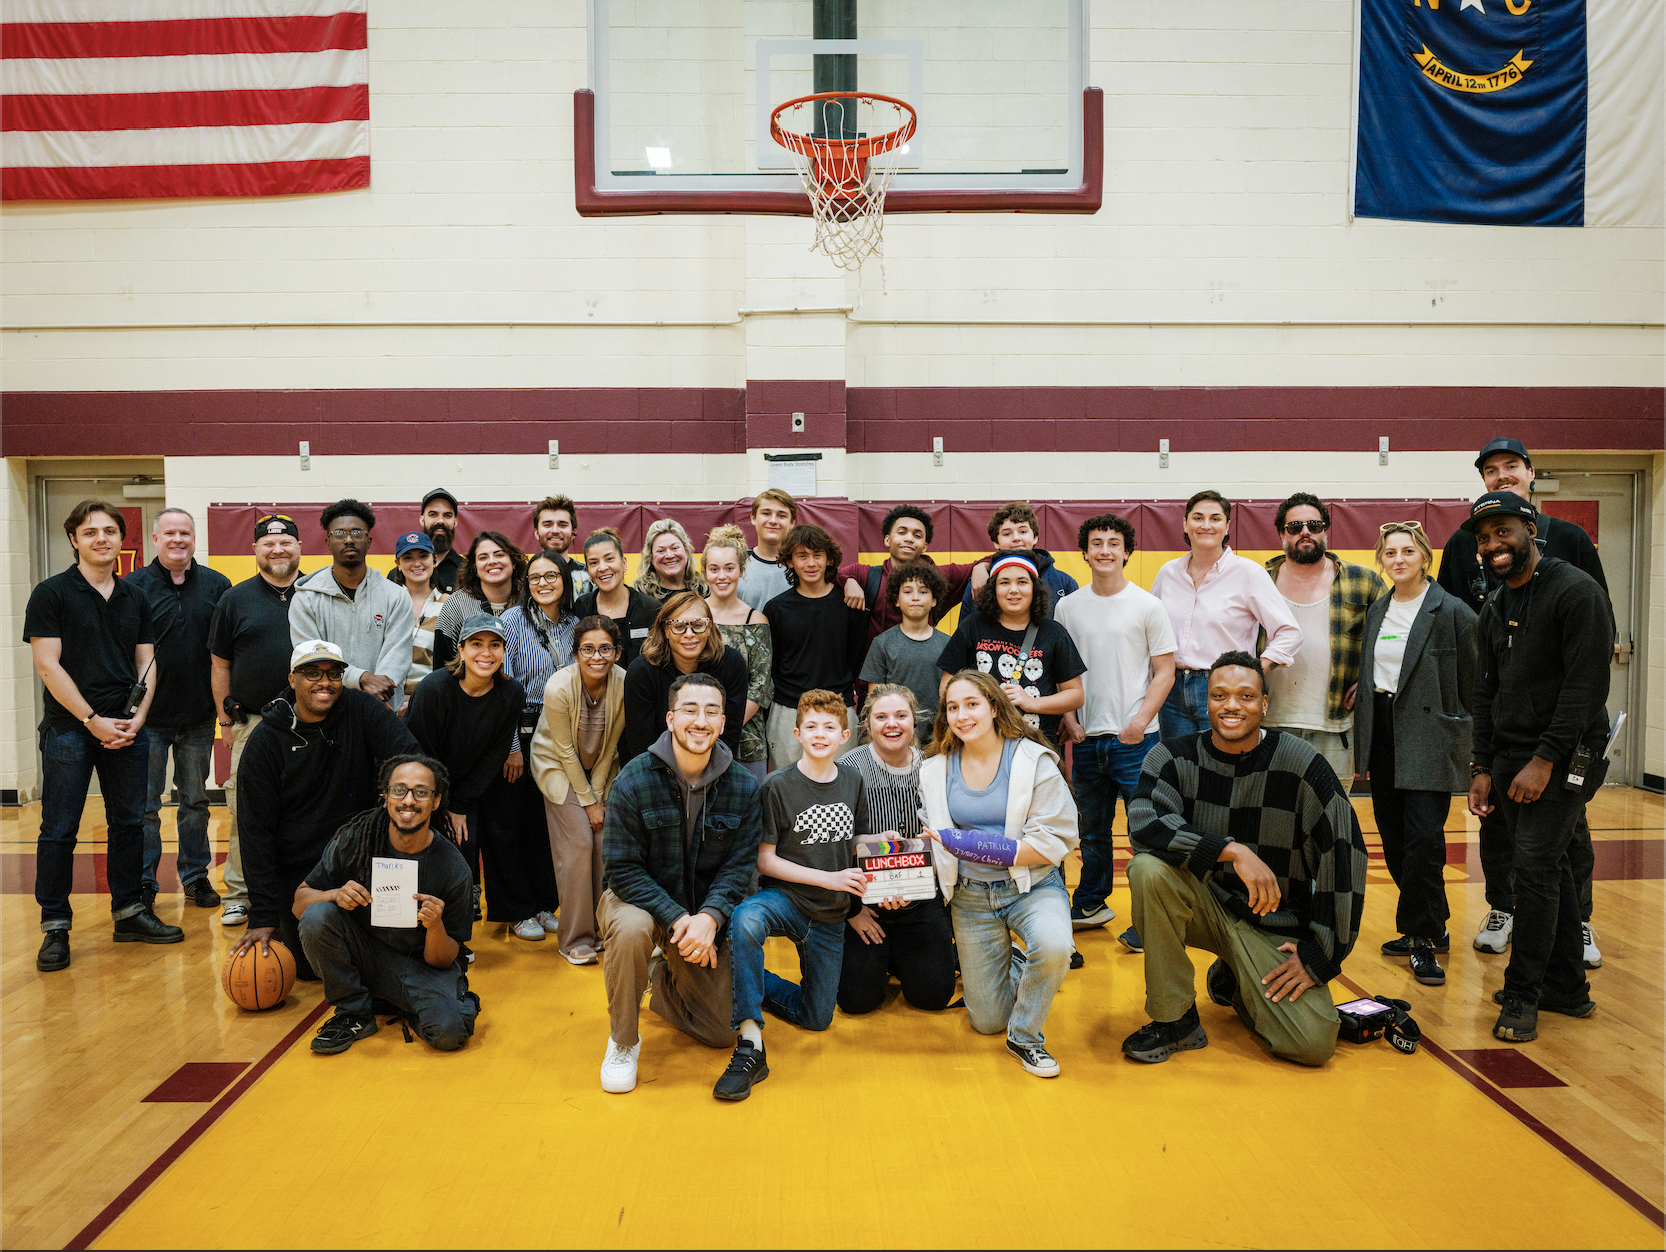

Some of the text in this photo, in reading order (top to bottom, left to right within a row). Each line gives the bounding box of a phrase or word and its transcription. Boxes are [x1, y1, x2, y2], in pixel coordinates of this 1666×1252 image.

[1426, 63, 1463, 87] APRIL
[1487, 67, 1517, 88] 1776
[1002, 645, 1043, 658] VOOEES
[977, 841, 1011, 852] PATRICK
[864, 853, 926, 871] LUNCHBOX
